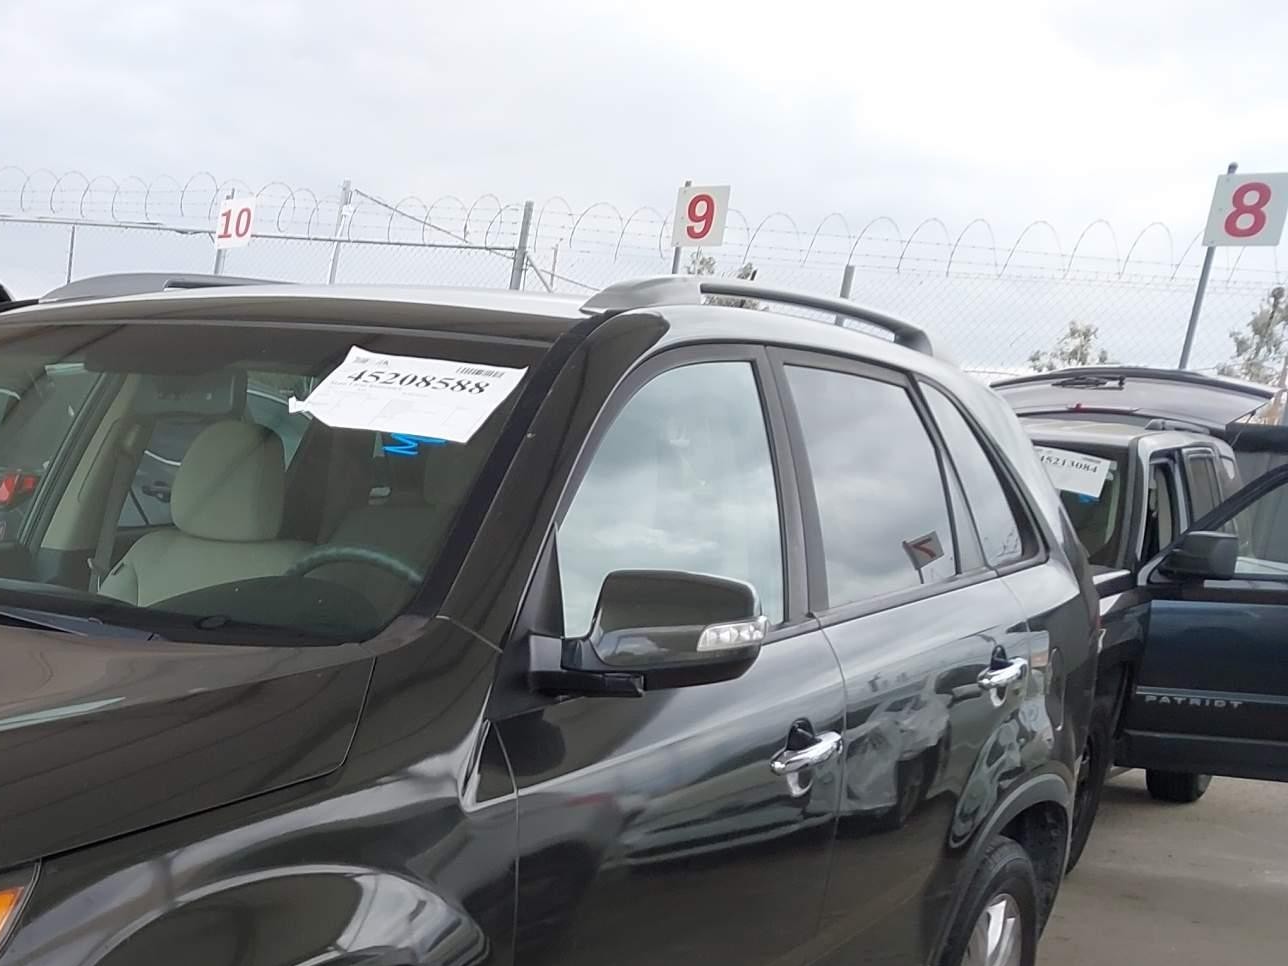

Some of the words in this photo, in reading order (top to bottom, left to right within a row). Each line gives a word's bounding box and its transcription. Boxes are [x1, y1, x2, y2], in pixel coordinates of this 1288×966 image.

[217, 207, 251, 238] 10
[686, 194, 715, 239] 9
[1224, 182, 1271, 237] 8
[346, 368, 490, 394] 45208588
[1145, 695, 1243, 708] PATRIOT
